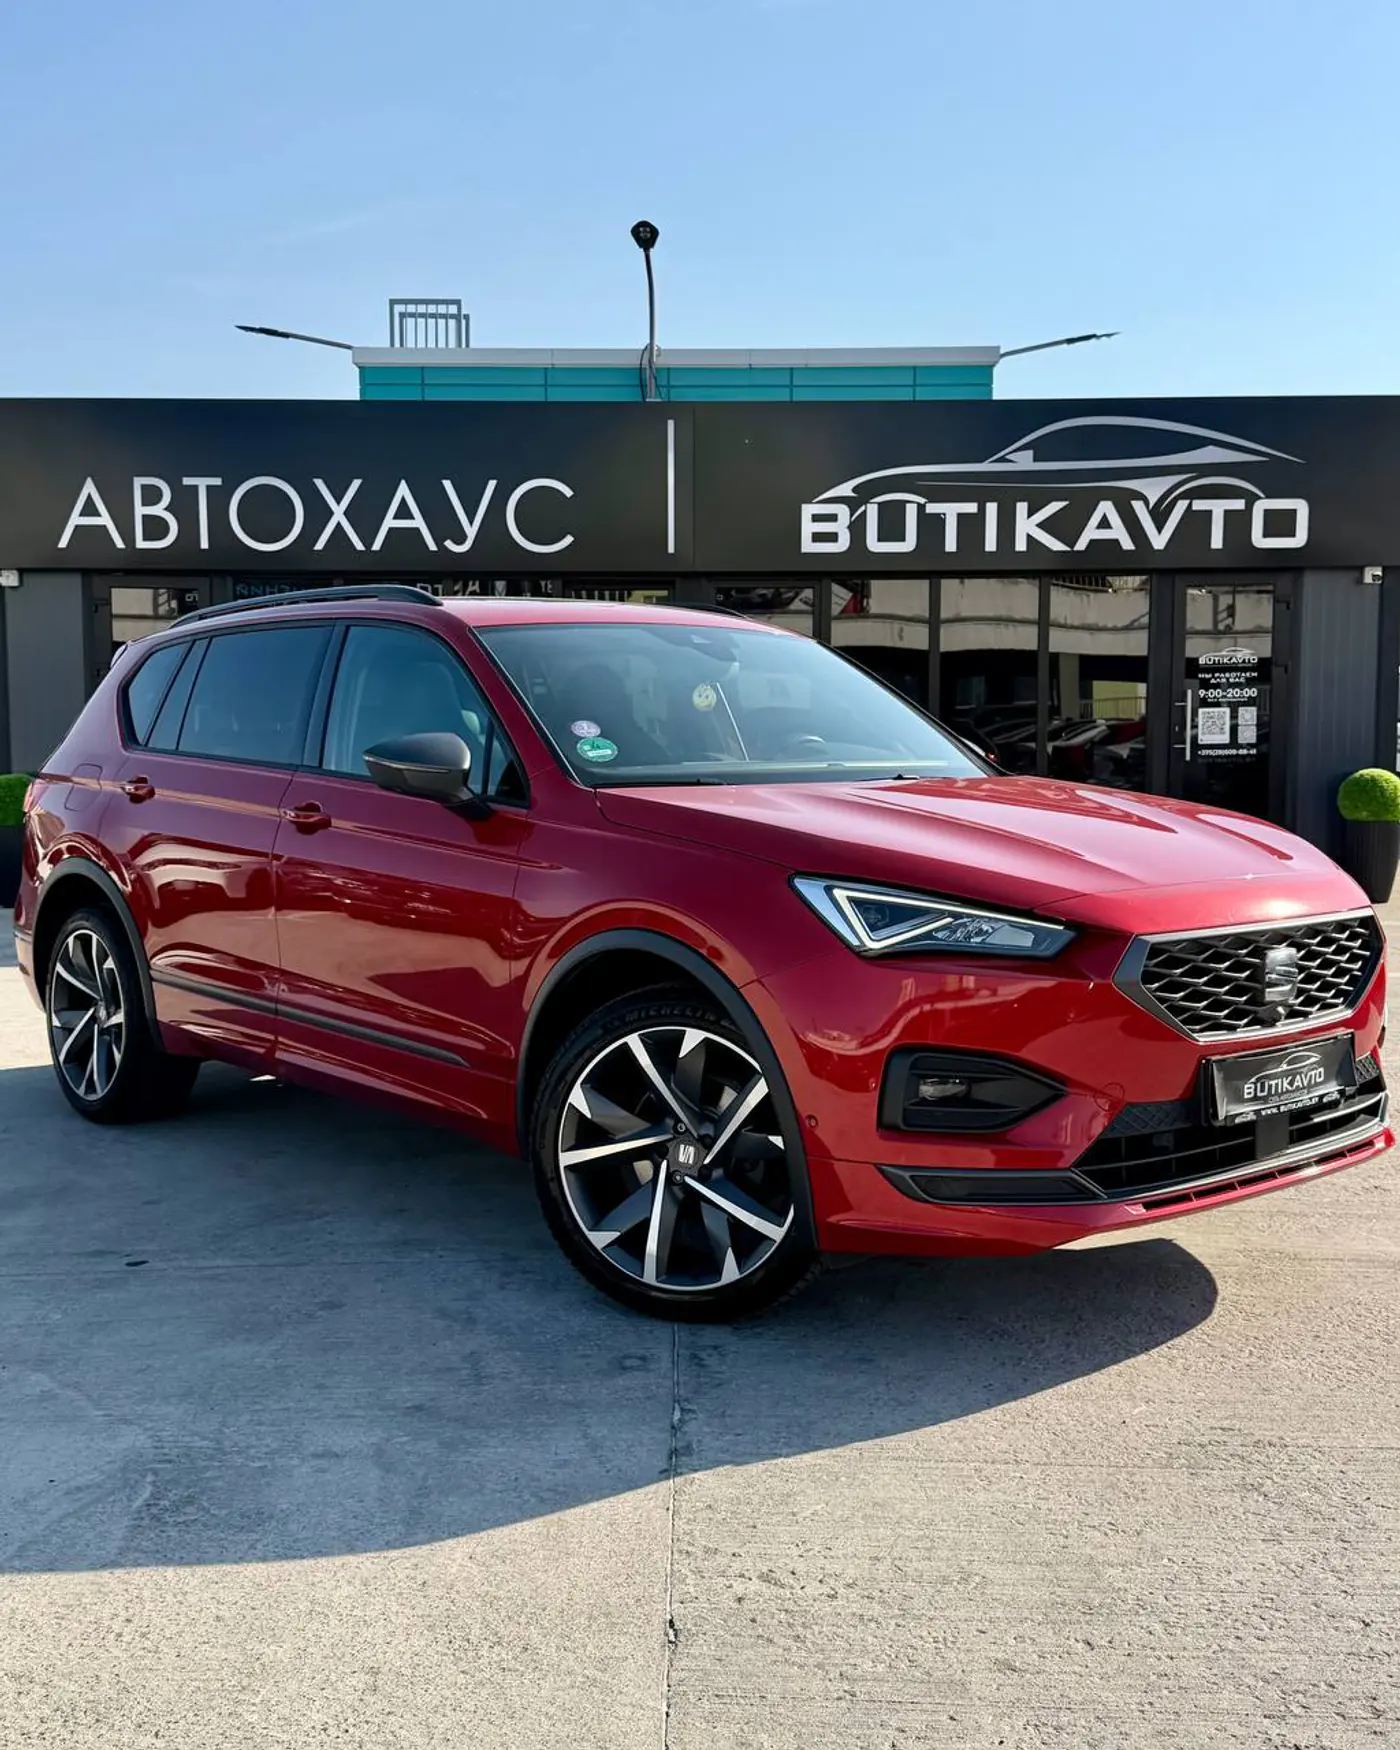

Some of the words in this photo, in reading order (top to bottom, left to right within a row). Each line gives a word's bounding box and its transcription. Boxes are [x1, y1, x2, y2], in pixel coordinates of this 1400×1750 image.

[57, 475, 575, 554] АВТОХАУС
[801, 497, 1310, 554] BUTIKAVTO
[1198, 656, 1258, 665] BUTIKAVTO
[1198, 688, 1258, 698] 9:00-20:00
[1244, 1067, 1325, 1098] BUTIKAVTO
